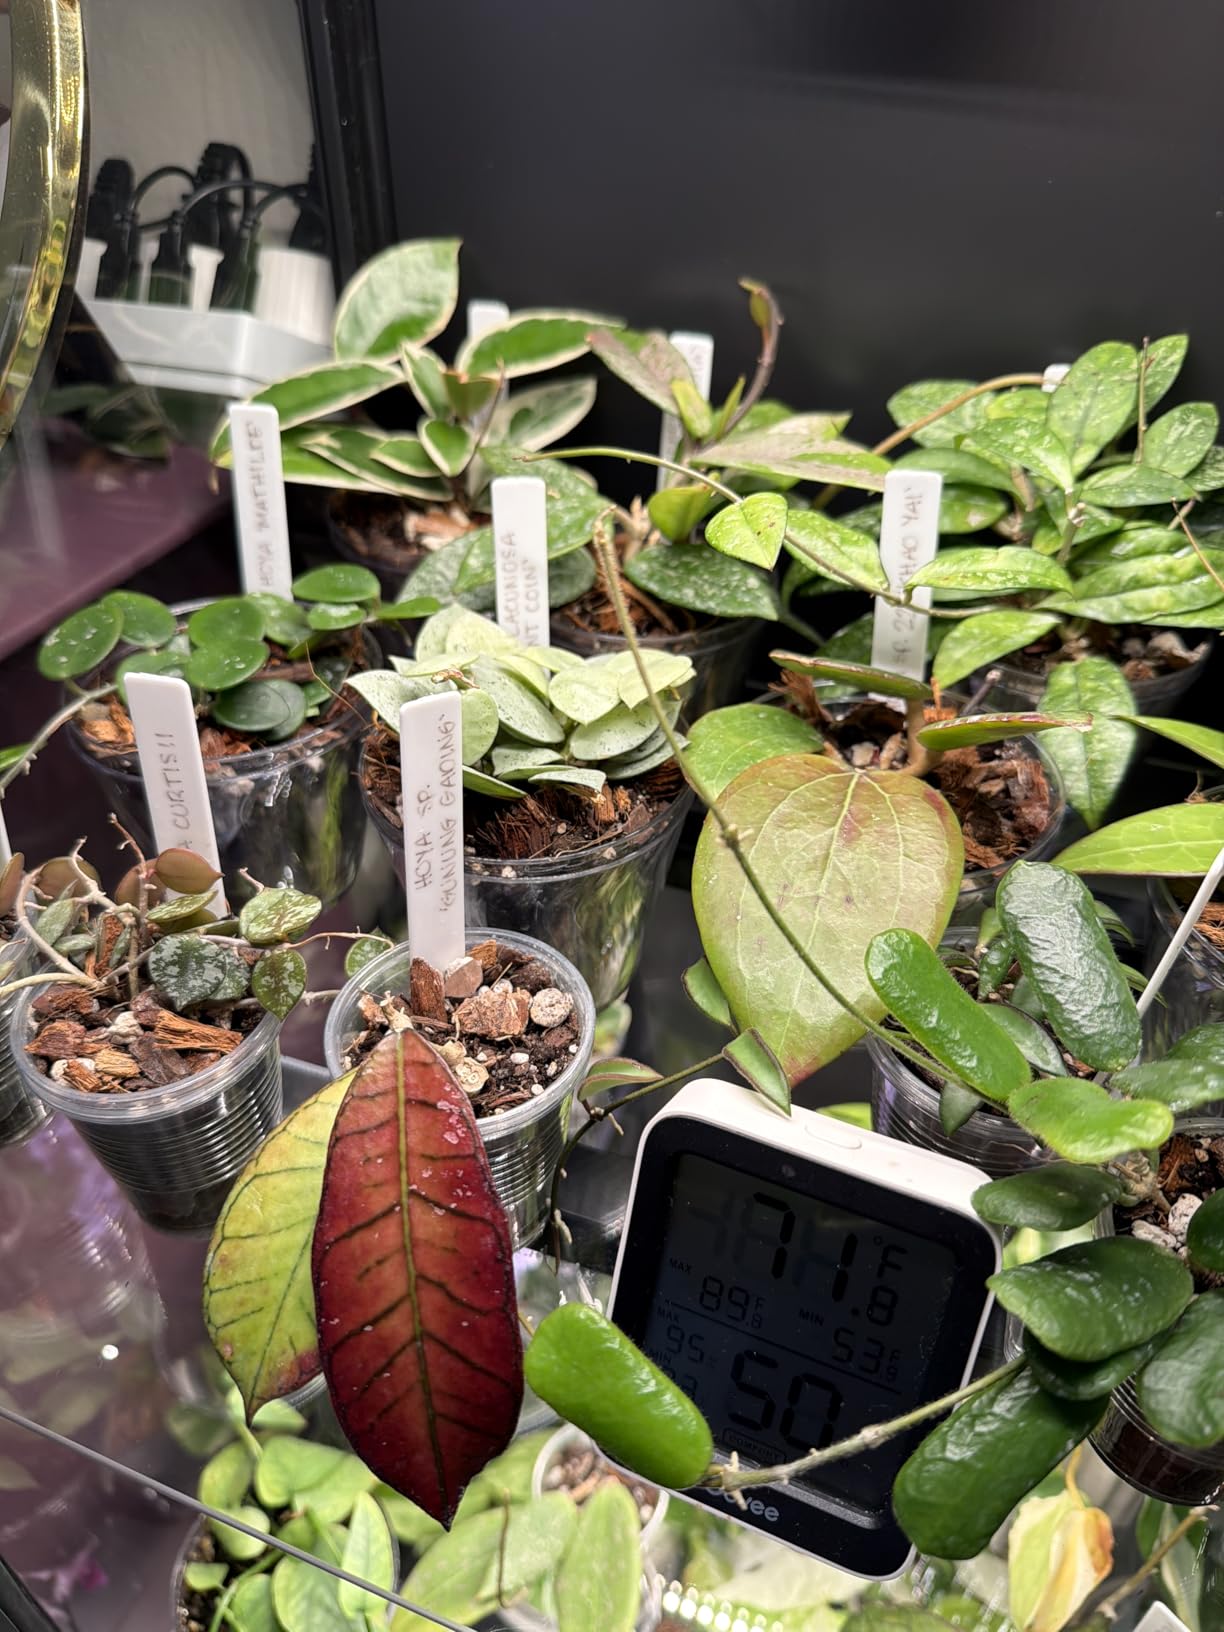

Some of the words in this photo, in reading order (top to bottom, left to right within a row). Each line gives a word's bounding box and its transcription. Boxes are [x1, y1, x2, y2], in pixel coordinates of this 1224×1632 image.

[257, 543, 274, 586] HOYA
[414, 831, 433, 890] HOYA
[668, 1257, 693, 1275] MAX
[656, 1305, 681, 1324] MAX
[799, 1308, 826, 1327] MIN
